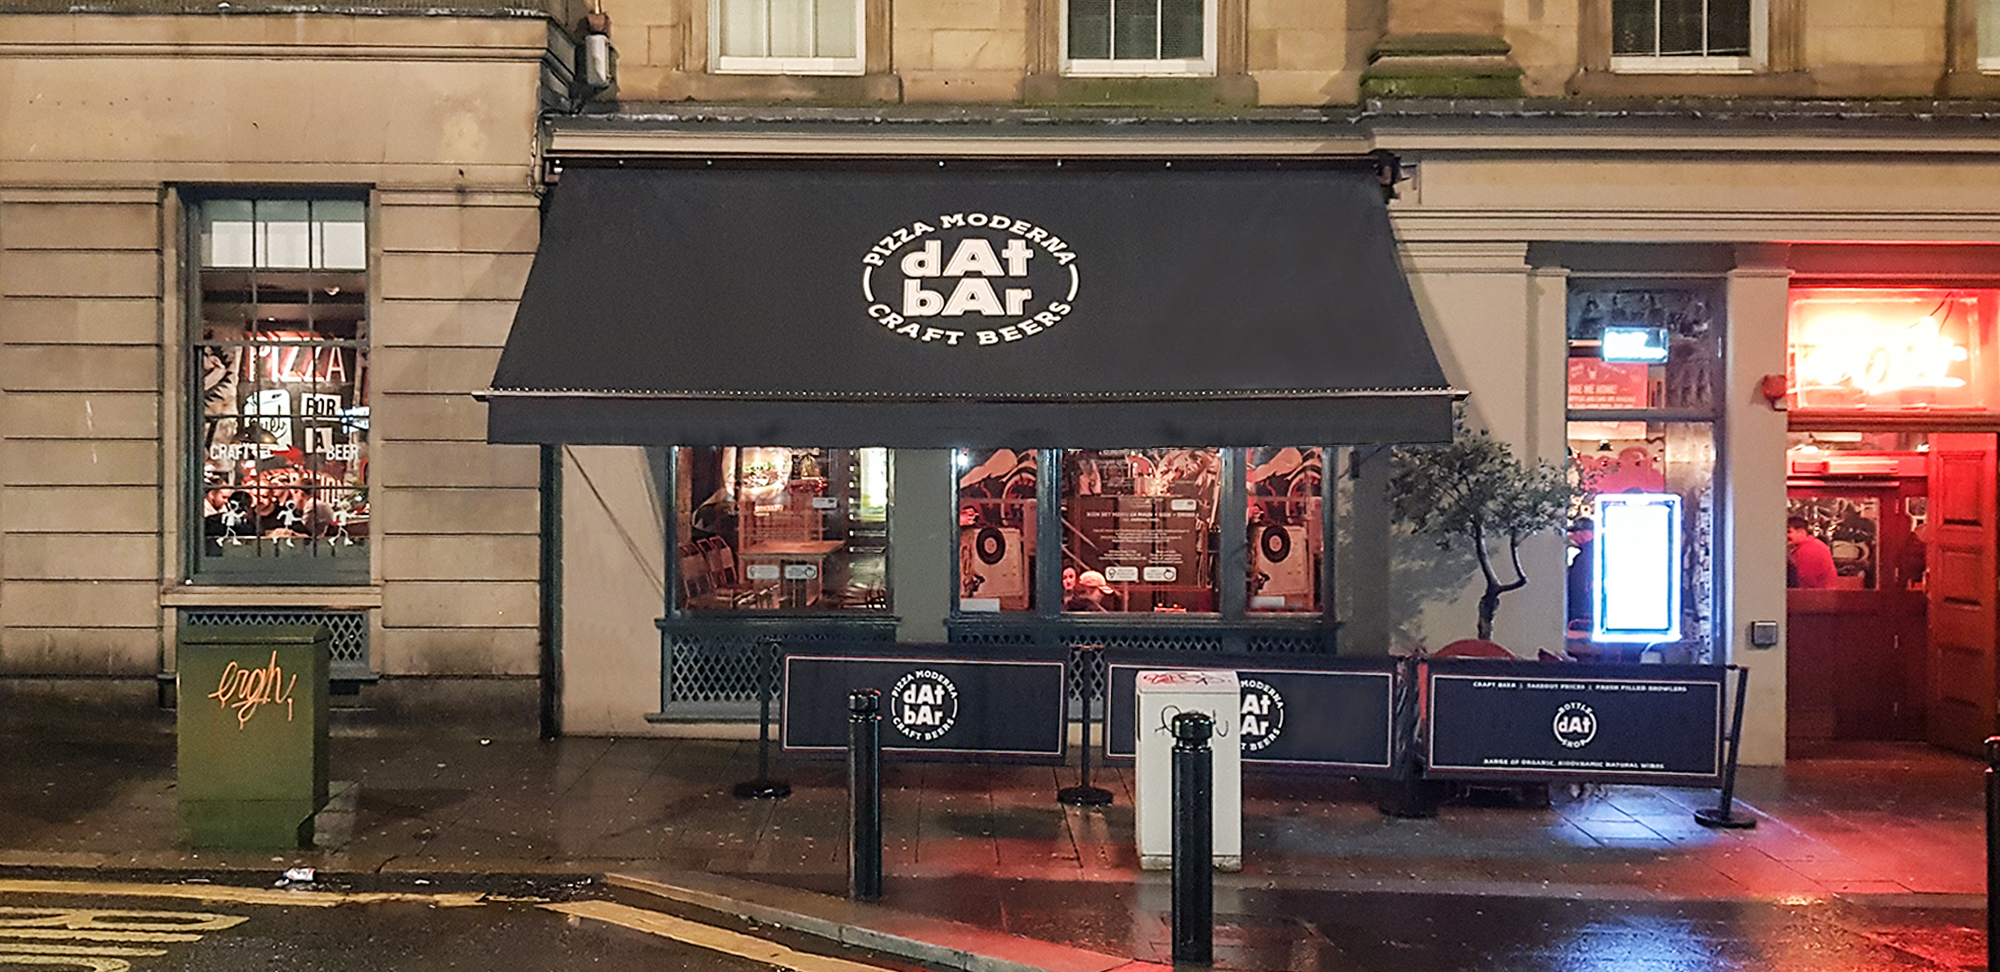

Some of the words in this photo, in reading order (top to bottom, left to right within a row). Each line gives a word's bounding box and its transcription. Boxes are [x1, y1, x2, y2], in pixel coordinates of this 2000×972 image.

[863, 220, 935, 267] PIZZA
[939, 212, 1078, 266] MODERNA
[900, 238, 1034, 277] dAt
[903, 277, 1033, 317] bAr
[868, 303, 965, 346] CRAFT
[976, 300, 1072, 346] BEERS
[248, 333, 346, 383] PIZZA
[306, 397, 336, 416] FOR
[210, 443, 249, 460] CRAFT
[326, 443, 359, 461] BEER
[892, 675, 914, 697] PIZZA
[917, 671, 957, 698] MODERNA
[903, 684, 945, 704] dAt
[903, 704, 943, 725] bAr
[1241, 693, 1271, 715] At
[1557, 702, 1593, 714] BOTTLE
[893, 717, 922, 740] CRAFT
[925, 719, 954, 740] BEERS
[1241, 715, 1269, 735] Ar
[1558, 716, 1592, 734] dAt
[1250, 728, 1281, 752] BEERS
[1561, 738, 1587, 749] SHOP
[1483, 758, 1508, 766] RANGE
